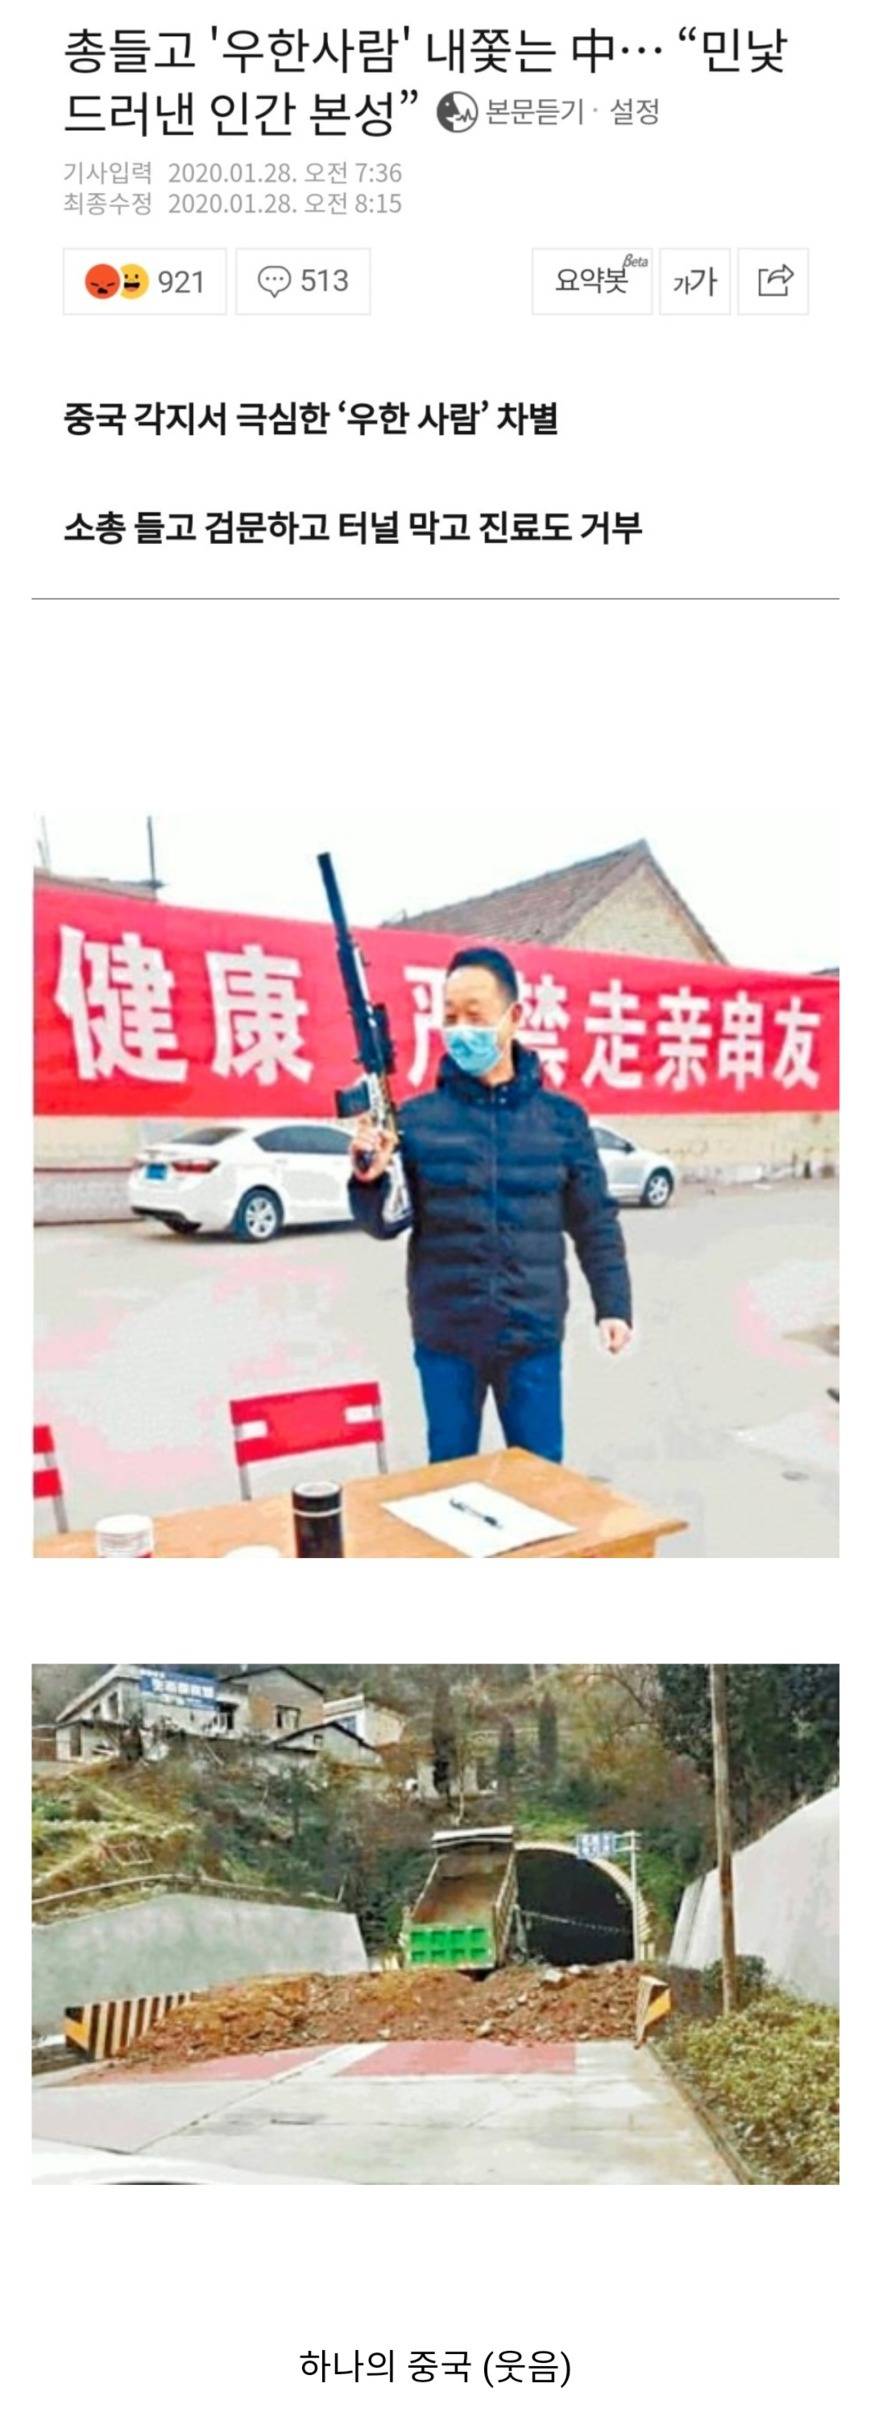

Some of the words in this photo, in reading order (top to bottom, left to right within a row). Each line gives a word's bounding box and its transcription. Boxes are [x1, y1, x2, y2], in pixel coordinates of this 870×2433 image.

[64, 28, 195, 73] 총들고
[212, 25, 409, 74] '우한사람'
[427, 28, 556, 74] 내쫓는
[679, 26, 788, 73] “민낯
[64, 92, 194, 137] 드러낸
[211, 92, 296, 136] 인간
[310, 89, 418, 137] 본성”
[486, 99, 582, 125] 본문듣기
[611, 98, 658, 125] 설정
[65, 162, 150, 184] 기사입력
[169, 163, 296, 182] 2020.01.28.
[305, 162, 346, 184] 오전
[356, 163, 401, 182] 7:36
[65, 193, 150, 215] 최종수정
[169, 194, 296, 213] 2020.01.28.
[305, 193, 346, 214] 오전
[355, 194, 401, 213] 8:15
[158, 271, 202, 293] 921
[302, 269, 348, 291] 513
[555, 267, 629, 294] 요약봇
[64, 403, 127, 436] 중국
[134, 402, 226, 436] 각지서
[236, 401, 331, 436] 극심한
[338, 400, 410, 436] ‘우한
[417, 400, 489, 436] 사람’
[497, 402, 558, 436] 차별
[64, 511, 126, 545] 소총
[134, 512, 197, 544] 들고
[205, 510, 330, 545] 검문하고
[339, 511, 399, 545] 터널
[409, 510, 470, 545] 막고
[479, 511, 572, 544] 진료도
[580, 511, 642, 545] 거부
[55, 924, 314, 1087] 健康
